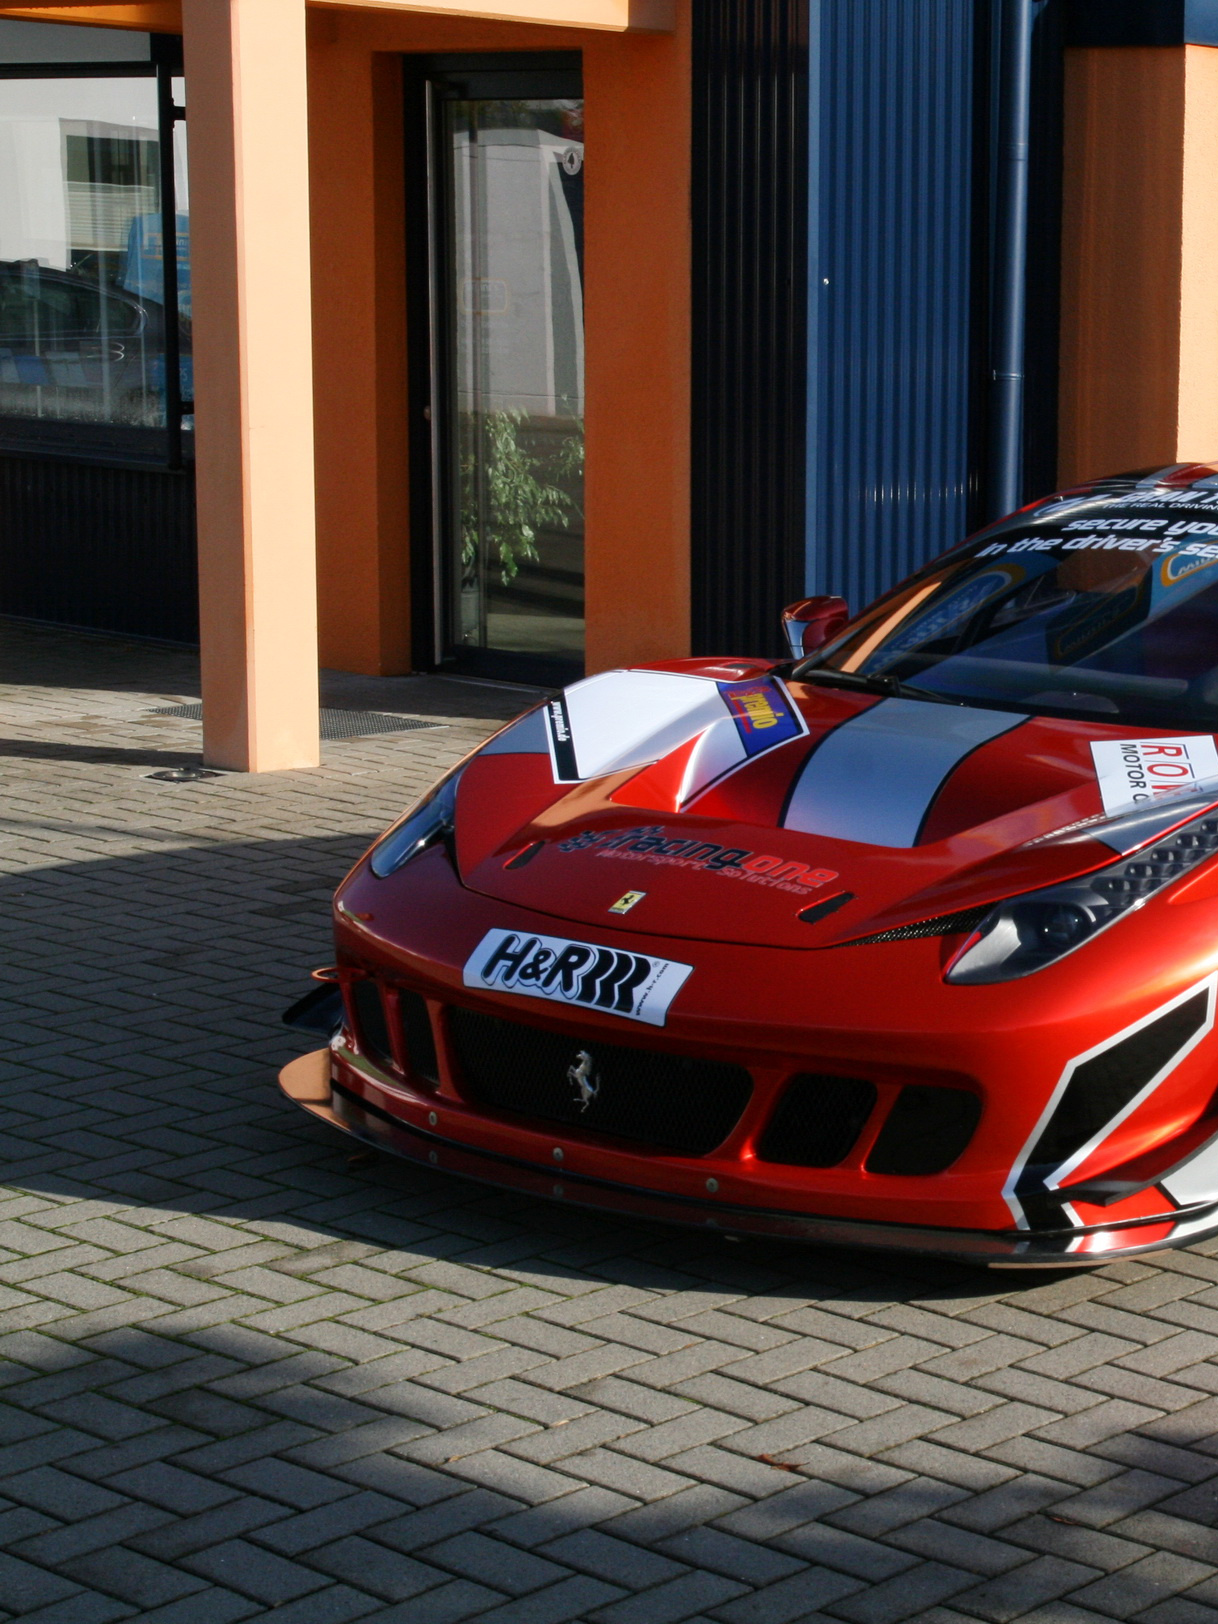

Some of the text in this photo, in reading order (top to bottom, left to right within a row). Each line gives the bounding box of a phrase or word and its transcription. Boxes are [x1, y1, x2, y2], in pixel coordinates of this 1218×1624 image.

[1120, 491, 1208, 504] GRAN
[1061, 519, 1168, 531] secure
[973, 542, 1007, 558] in
[1006, 537, 1062, 553] the
[1061, 534, 1181, 553] driver's
[730, 692, 785, 729] premio
[1119, 743, 1147, 789] MOTOR
[481, 933, 598, 1000] H&R
[636, 963, 669, 1016] www.h-r.com
